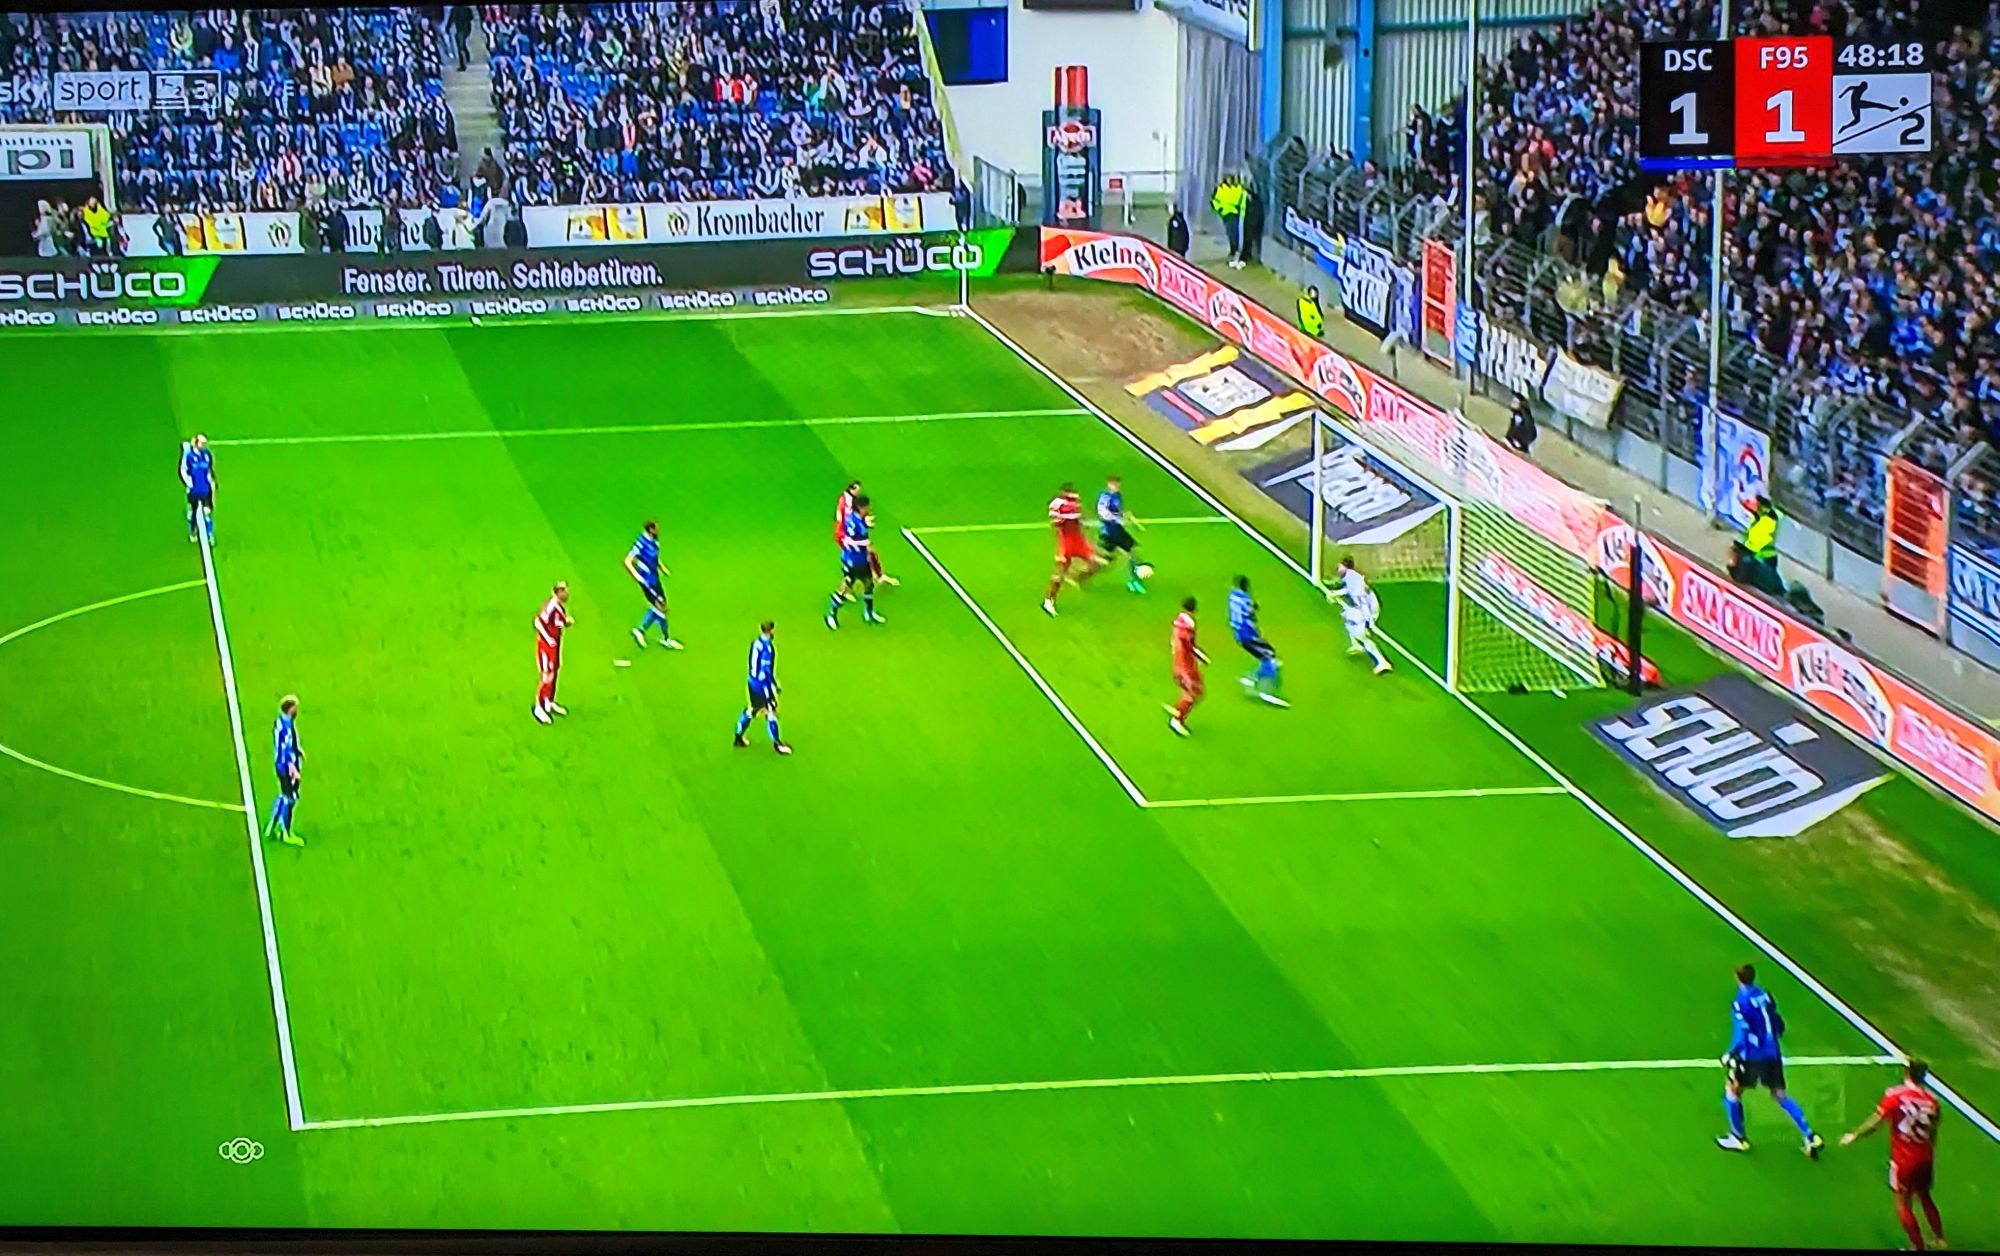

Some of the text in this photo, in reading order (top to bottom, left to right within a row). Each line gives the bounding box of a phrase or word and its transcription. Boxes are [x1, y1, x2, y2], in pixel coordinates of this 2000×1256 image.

[1664, 48, 1713, 72] DSC
[1760, 46, 1809, 70] F95
[1837, 42, 1924, 67] 48:18
[1669, 92, 1709, 145] 1
[1765, 90, 1805, 142] 1
[1899, 113, 1926, 146] 2
[697, 203, 825, 236] Krombacher
[809, 238, 982, 277] SCHÜCO
[0, 263, 186, 299] SCHÜCO
[343, 266, 431, 294] Fenster.
